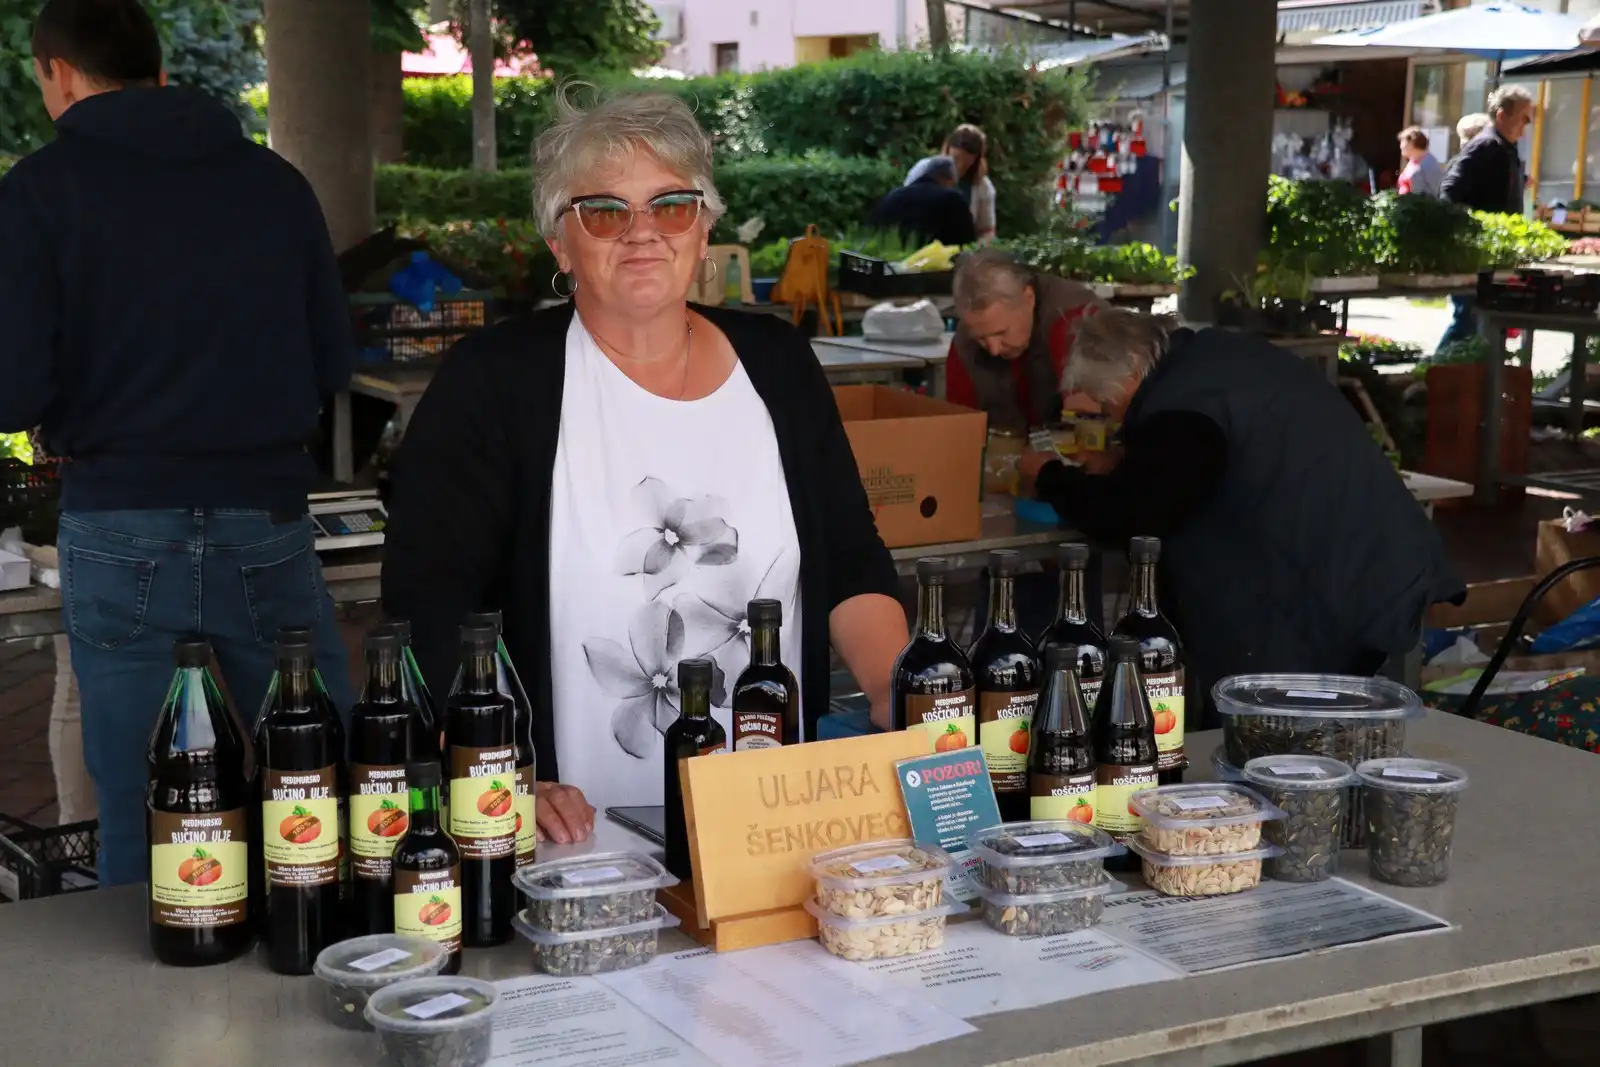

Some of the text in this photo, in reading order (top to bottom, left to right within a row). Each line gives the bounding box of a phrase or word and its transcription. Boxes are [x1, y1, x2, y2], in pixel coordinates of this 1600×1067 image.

[921, 706, 960, 723] KOŠČIČNO
[469, 761, 502, 777] BUČINO
[922, 760, 984, 784] POZOR!
[360, 779, 393, 794] BUČINO
[758, 763, 880, 809] ULJARA
[1113, 773, 1151, 786] KOŠČIČNO
[271, 785, 330, 801] BUČINO ULJE
[1051, 782, 1090, 797] KOŠČIČNO
[171, 828, 232, 844] BUČINO ULJE
[746, 810, 905, 858] ŠENKOVEC
